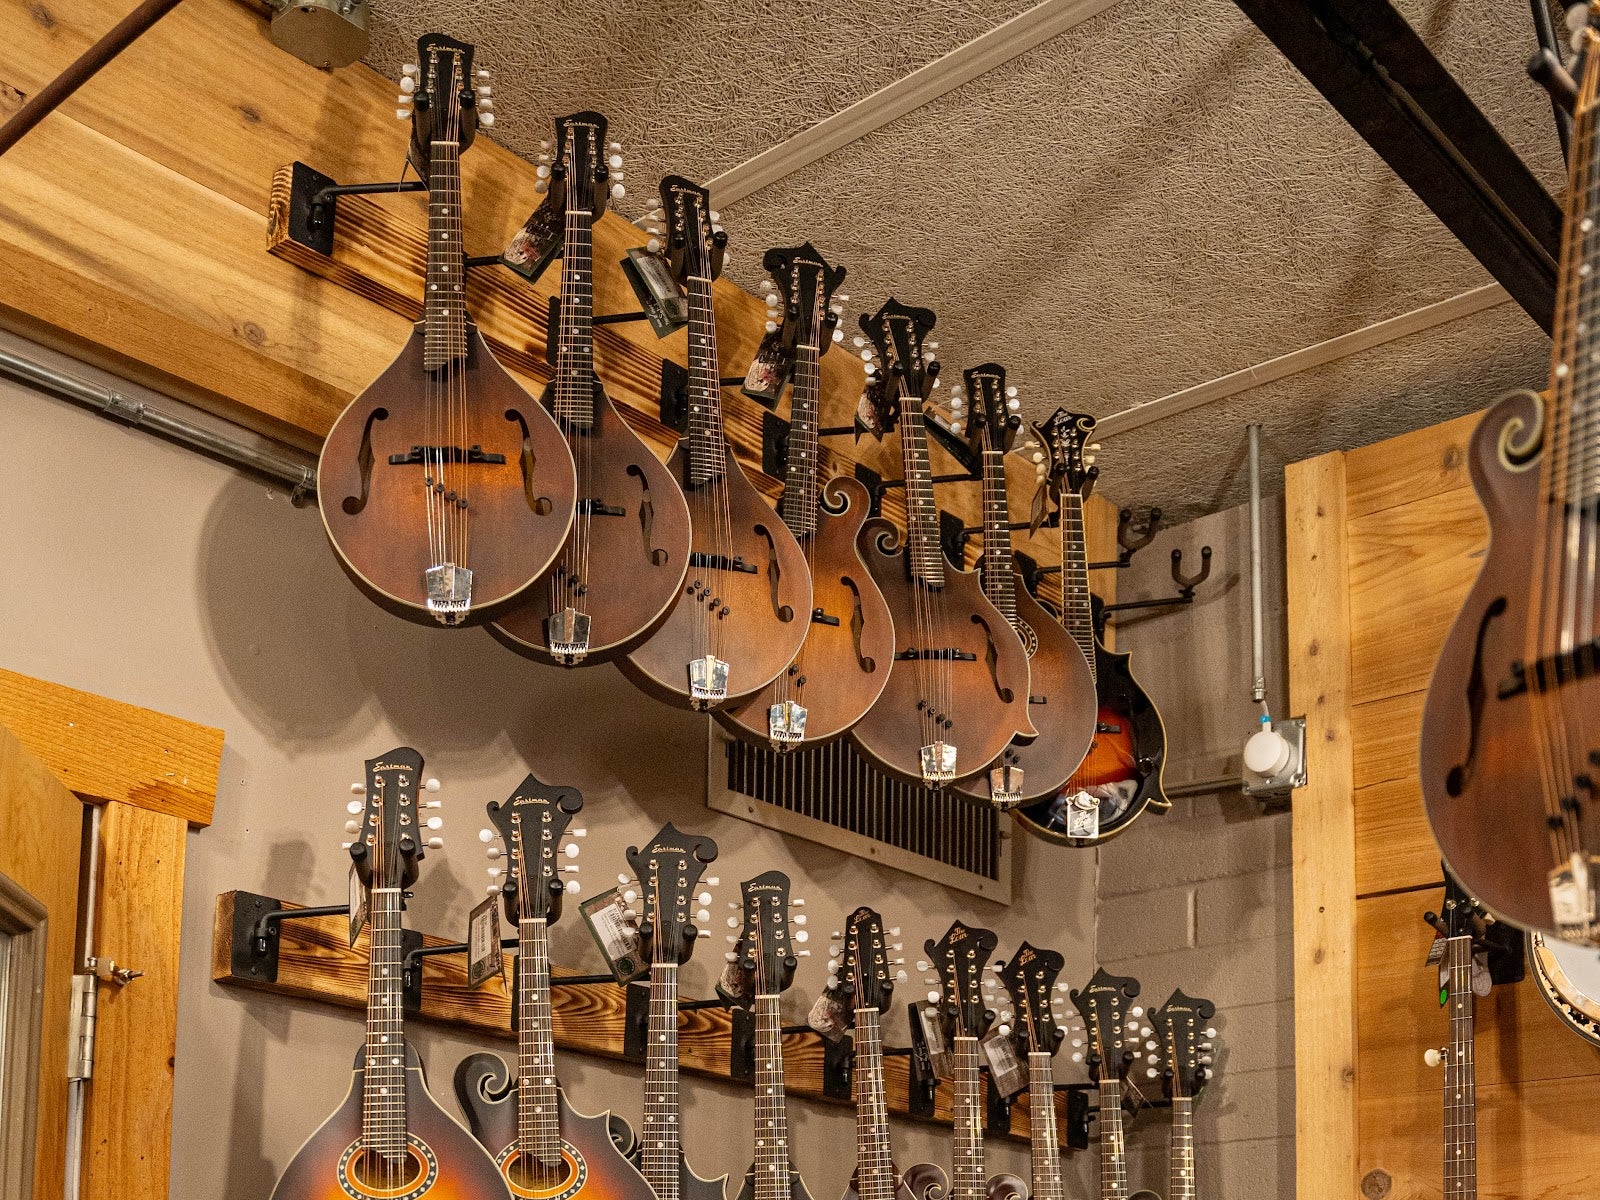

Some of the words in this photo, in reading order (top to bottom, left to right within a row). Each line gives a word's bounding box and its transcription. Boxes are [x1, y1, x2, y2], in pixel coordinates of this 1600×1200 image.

[372, 762, 413, 772] Eastman
[513, 796, 550, 806] Eastman
[652, 844, 686, 854] Eastman
[748, 883, 782, 892] Eastman
[1089, 984, 1116, 993] Eastman
[1166, 1004, 1192, 1012] Eastman
